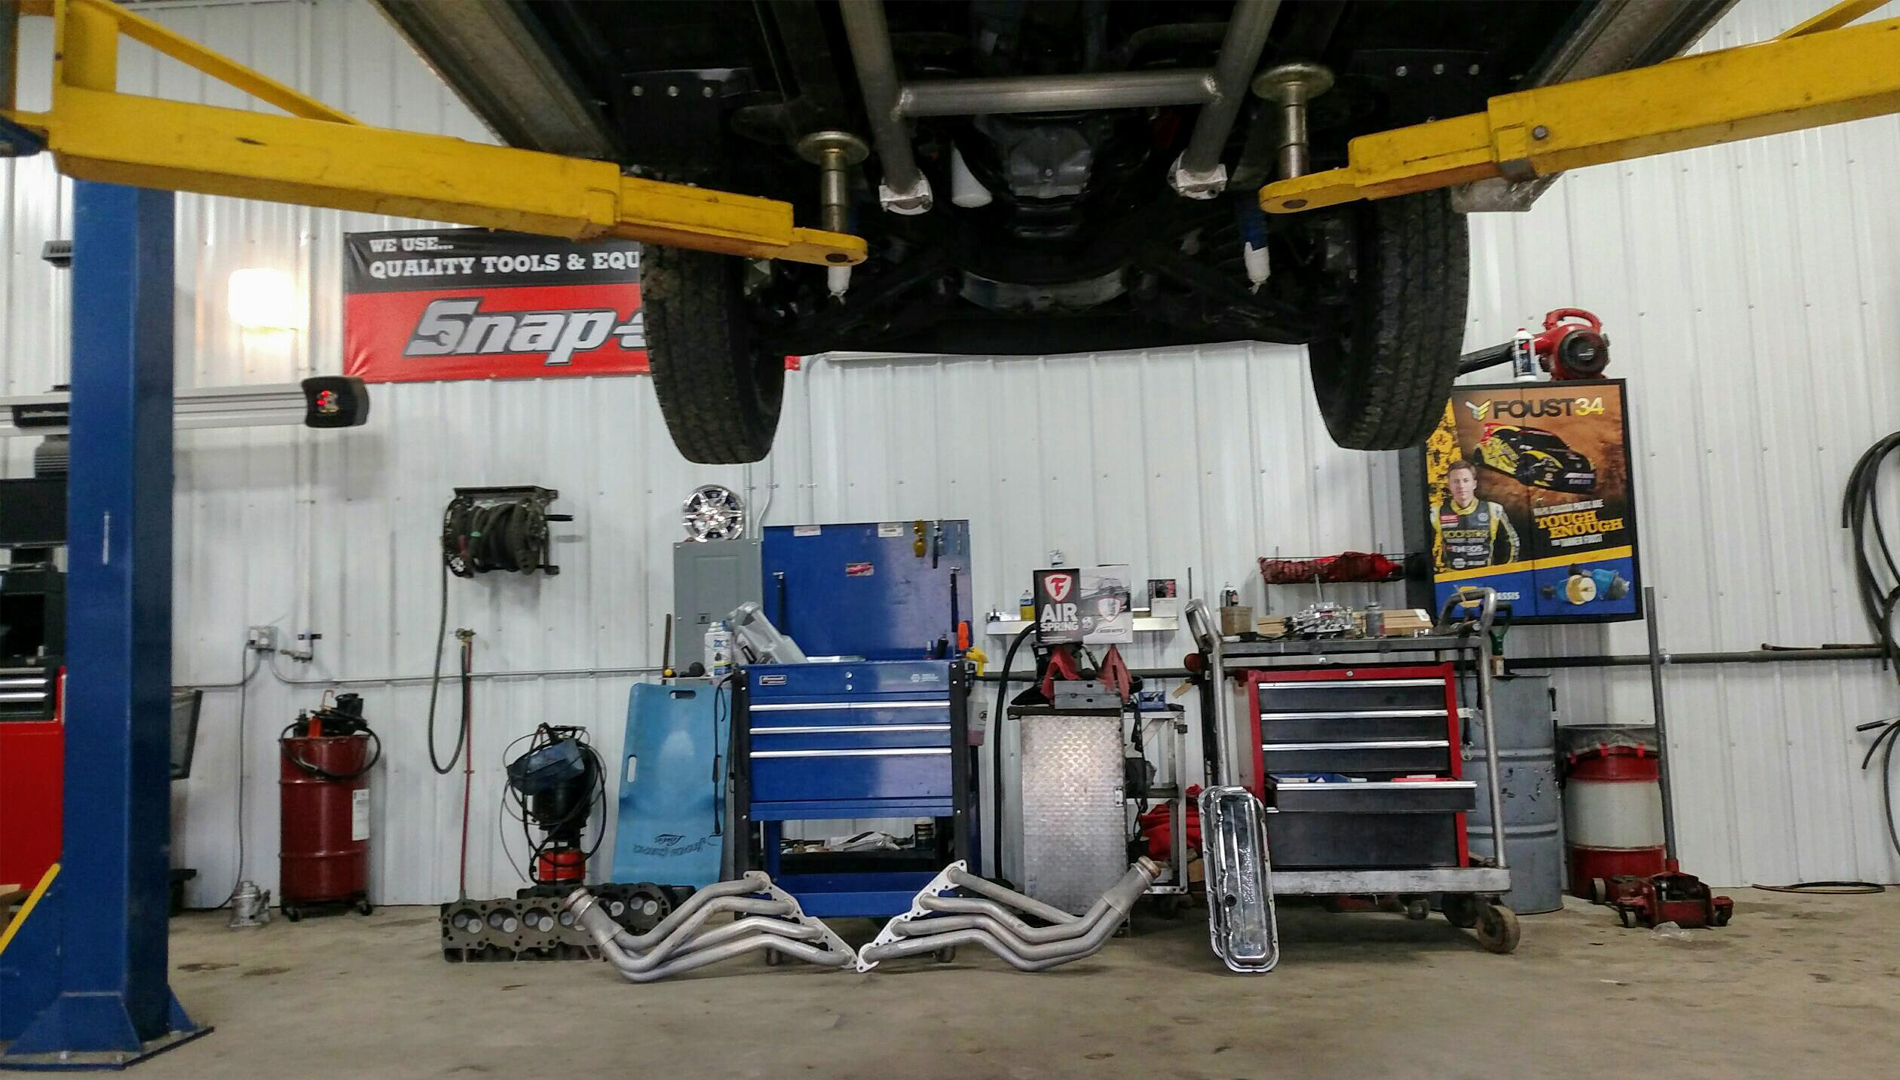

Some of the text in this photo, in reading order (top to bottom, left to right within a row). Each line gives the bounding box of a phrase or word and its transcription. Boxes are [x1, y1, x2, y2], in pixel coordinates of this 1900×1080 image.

[369, 236, 455, 253] WE USE...
[369, 251, 639, 279] QUALITY TOOLS & EQU
[1493, 396, 1605, 419] FOUST34
[1535, 510, 1598, 529] TOUGH
[1548, 518, 1625, 539] ENOUGH
[1040, 603, 1079, 622] AIR
[1040, 621, 1079, 632] SPRING
